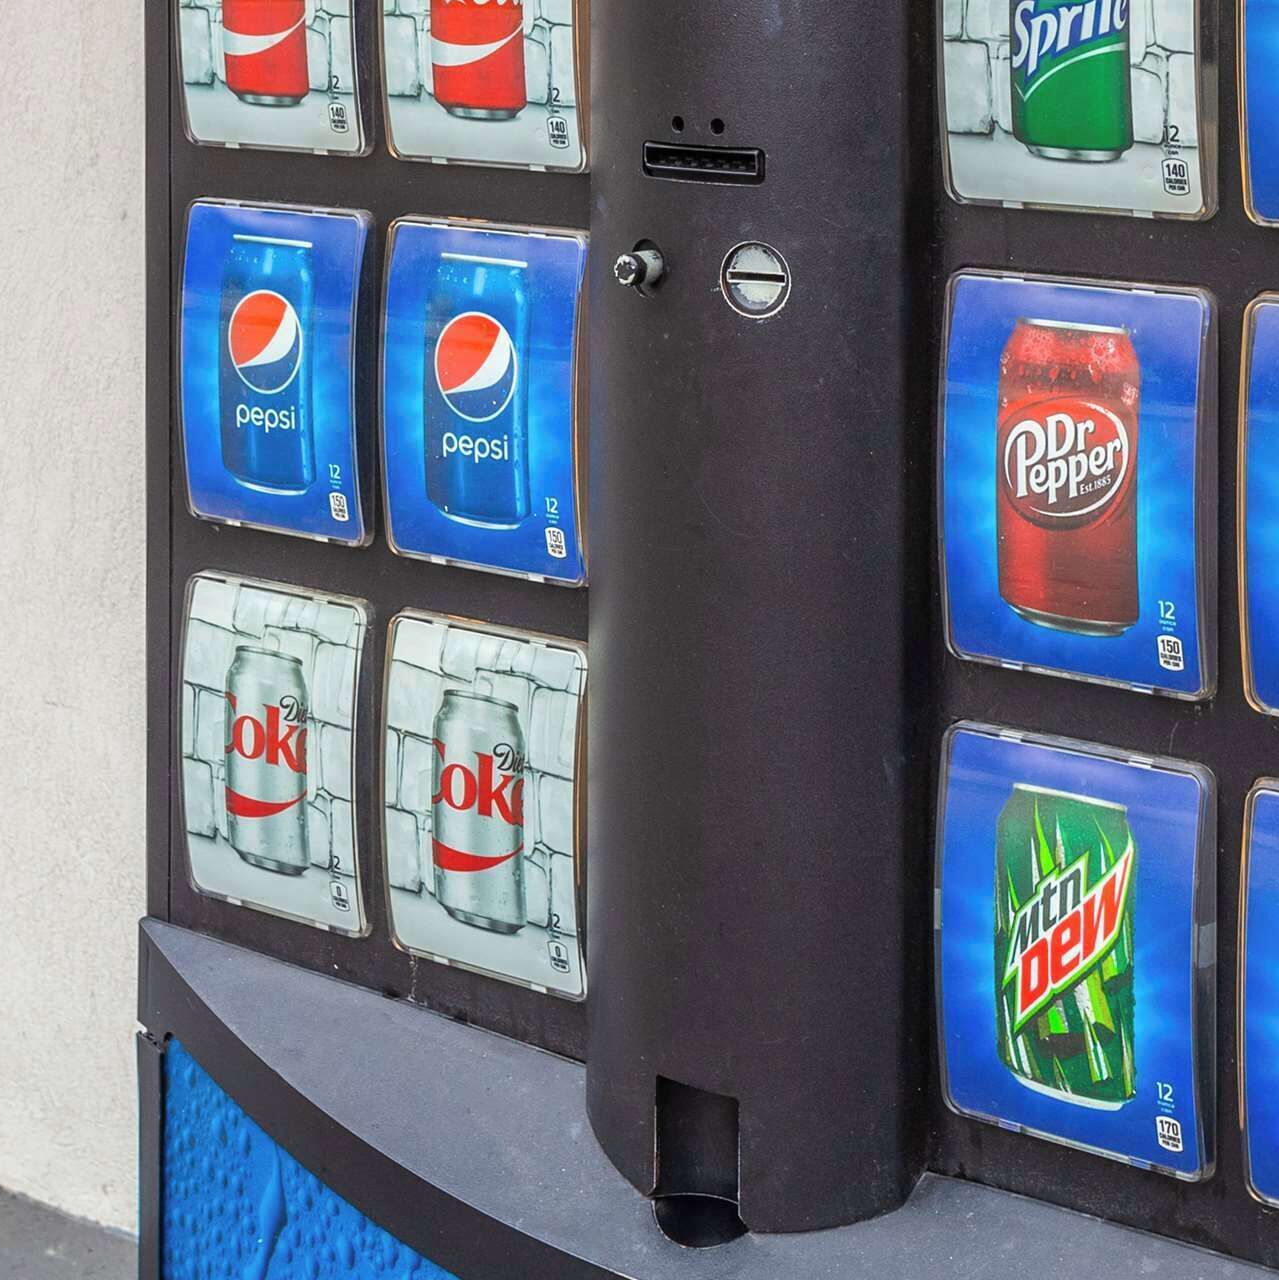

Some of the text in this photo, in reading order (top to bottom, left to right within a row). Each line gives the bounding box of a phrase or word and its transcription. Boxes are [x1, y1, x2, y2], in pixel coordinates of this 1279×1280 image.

[330, 106, 345, 119] 140
[549, 120, 566, 134] 140
[1165, 163, 1186, 178] 140
[236, 403, 296, 433] pepsi
[1046, 413, 1095, 460] Dr
[442, 431, 508, 463] pepsi
[1005, 419, 1122, 505] Pepper
[328, 463, 341, 480] 12
[545, 497, 559, 514] 12
[1158, 600, 1176, 620] 12
[1160, 639, 1180, 655] 150
[1011, 868, 1081, 966] Mtn
[1156, 1081, 1174, 1102] 12
[1159, 1119, 1179, 1136] 170
